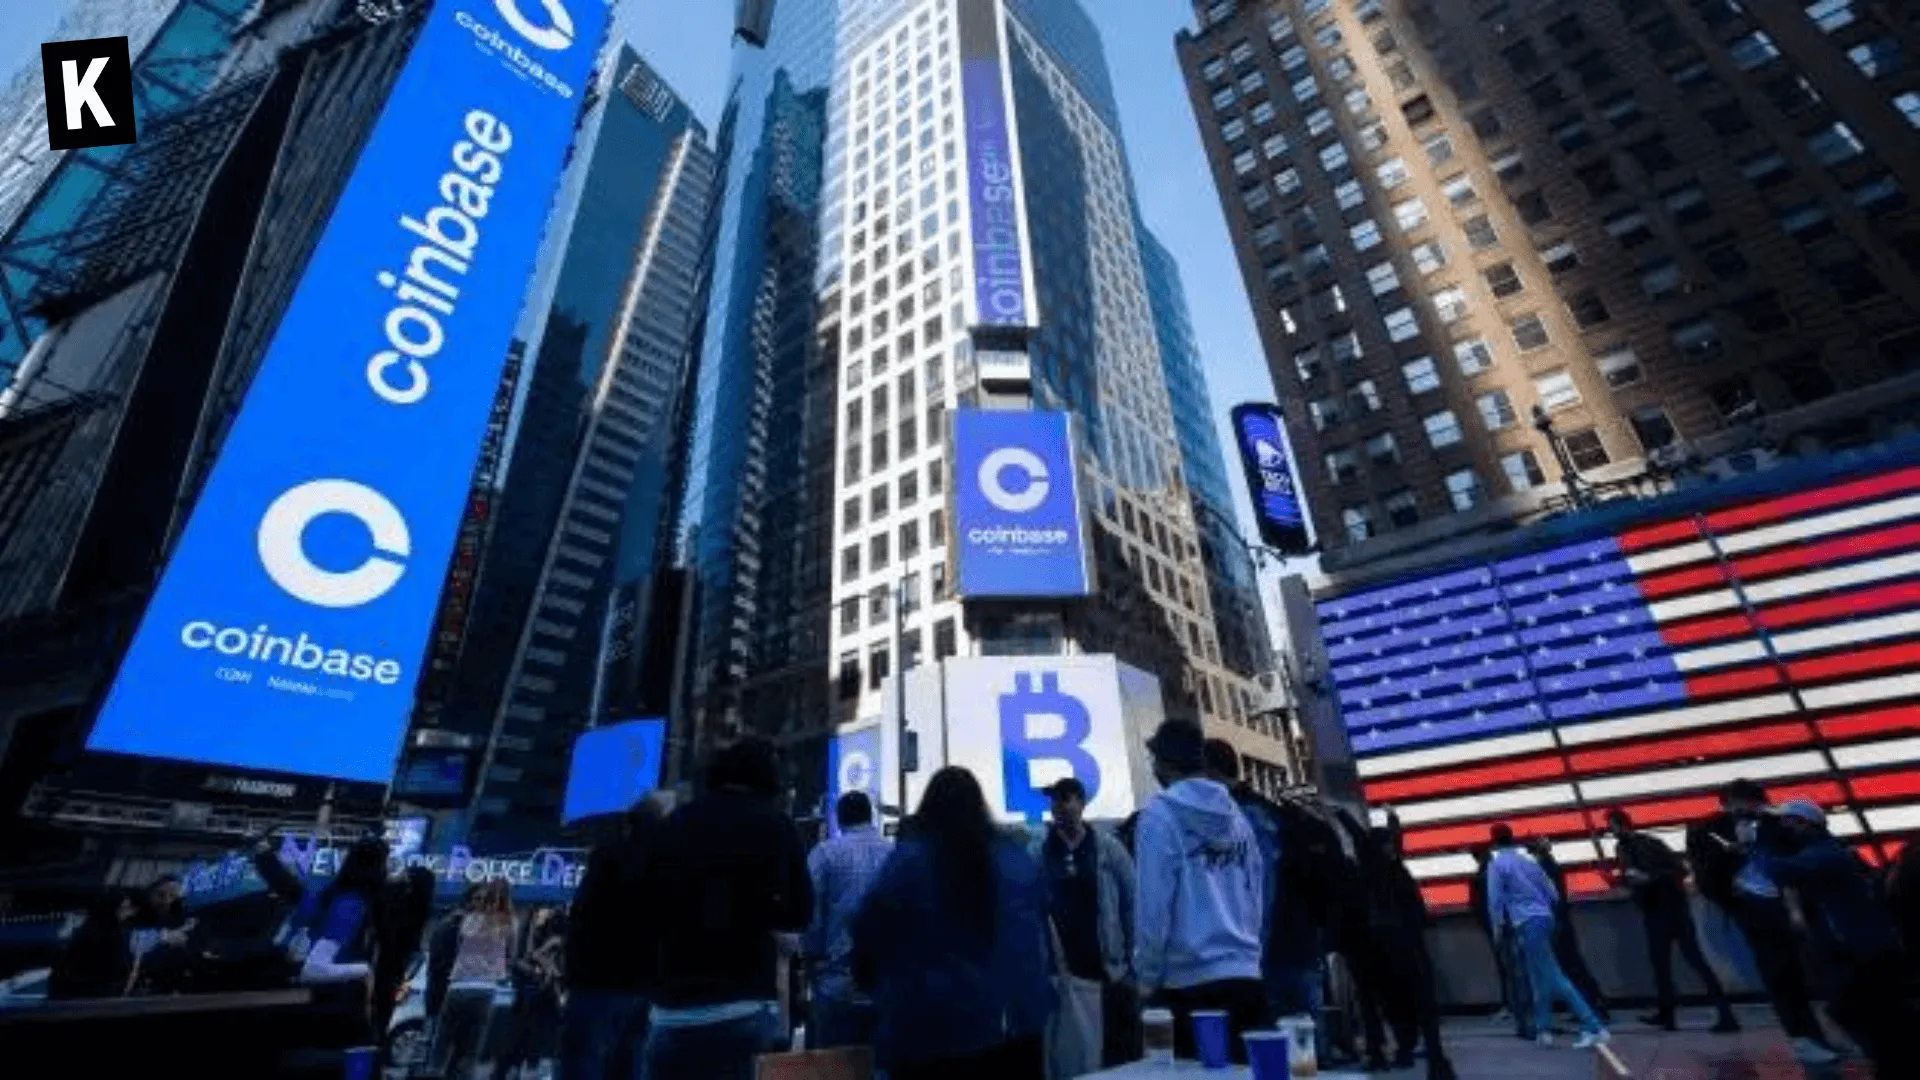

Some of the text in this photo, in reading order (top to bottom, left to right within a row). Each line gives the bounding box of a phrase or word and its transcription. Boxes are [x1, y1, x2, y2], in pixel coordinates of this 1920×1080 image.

[456, 11, 573, 99] coinbase
[367, 109, 512, 404] coinbase
[968, 524, 1069, 544] coinbase
[182, 620, 401, 684] coinbase
